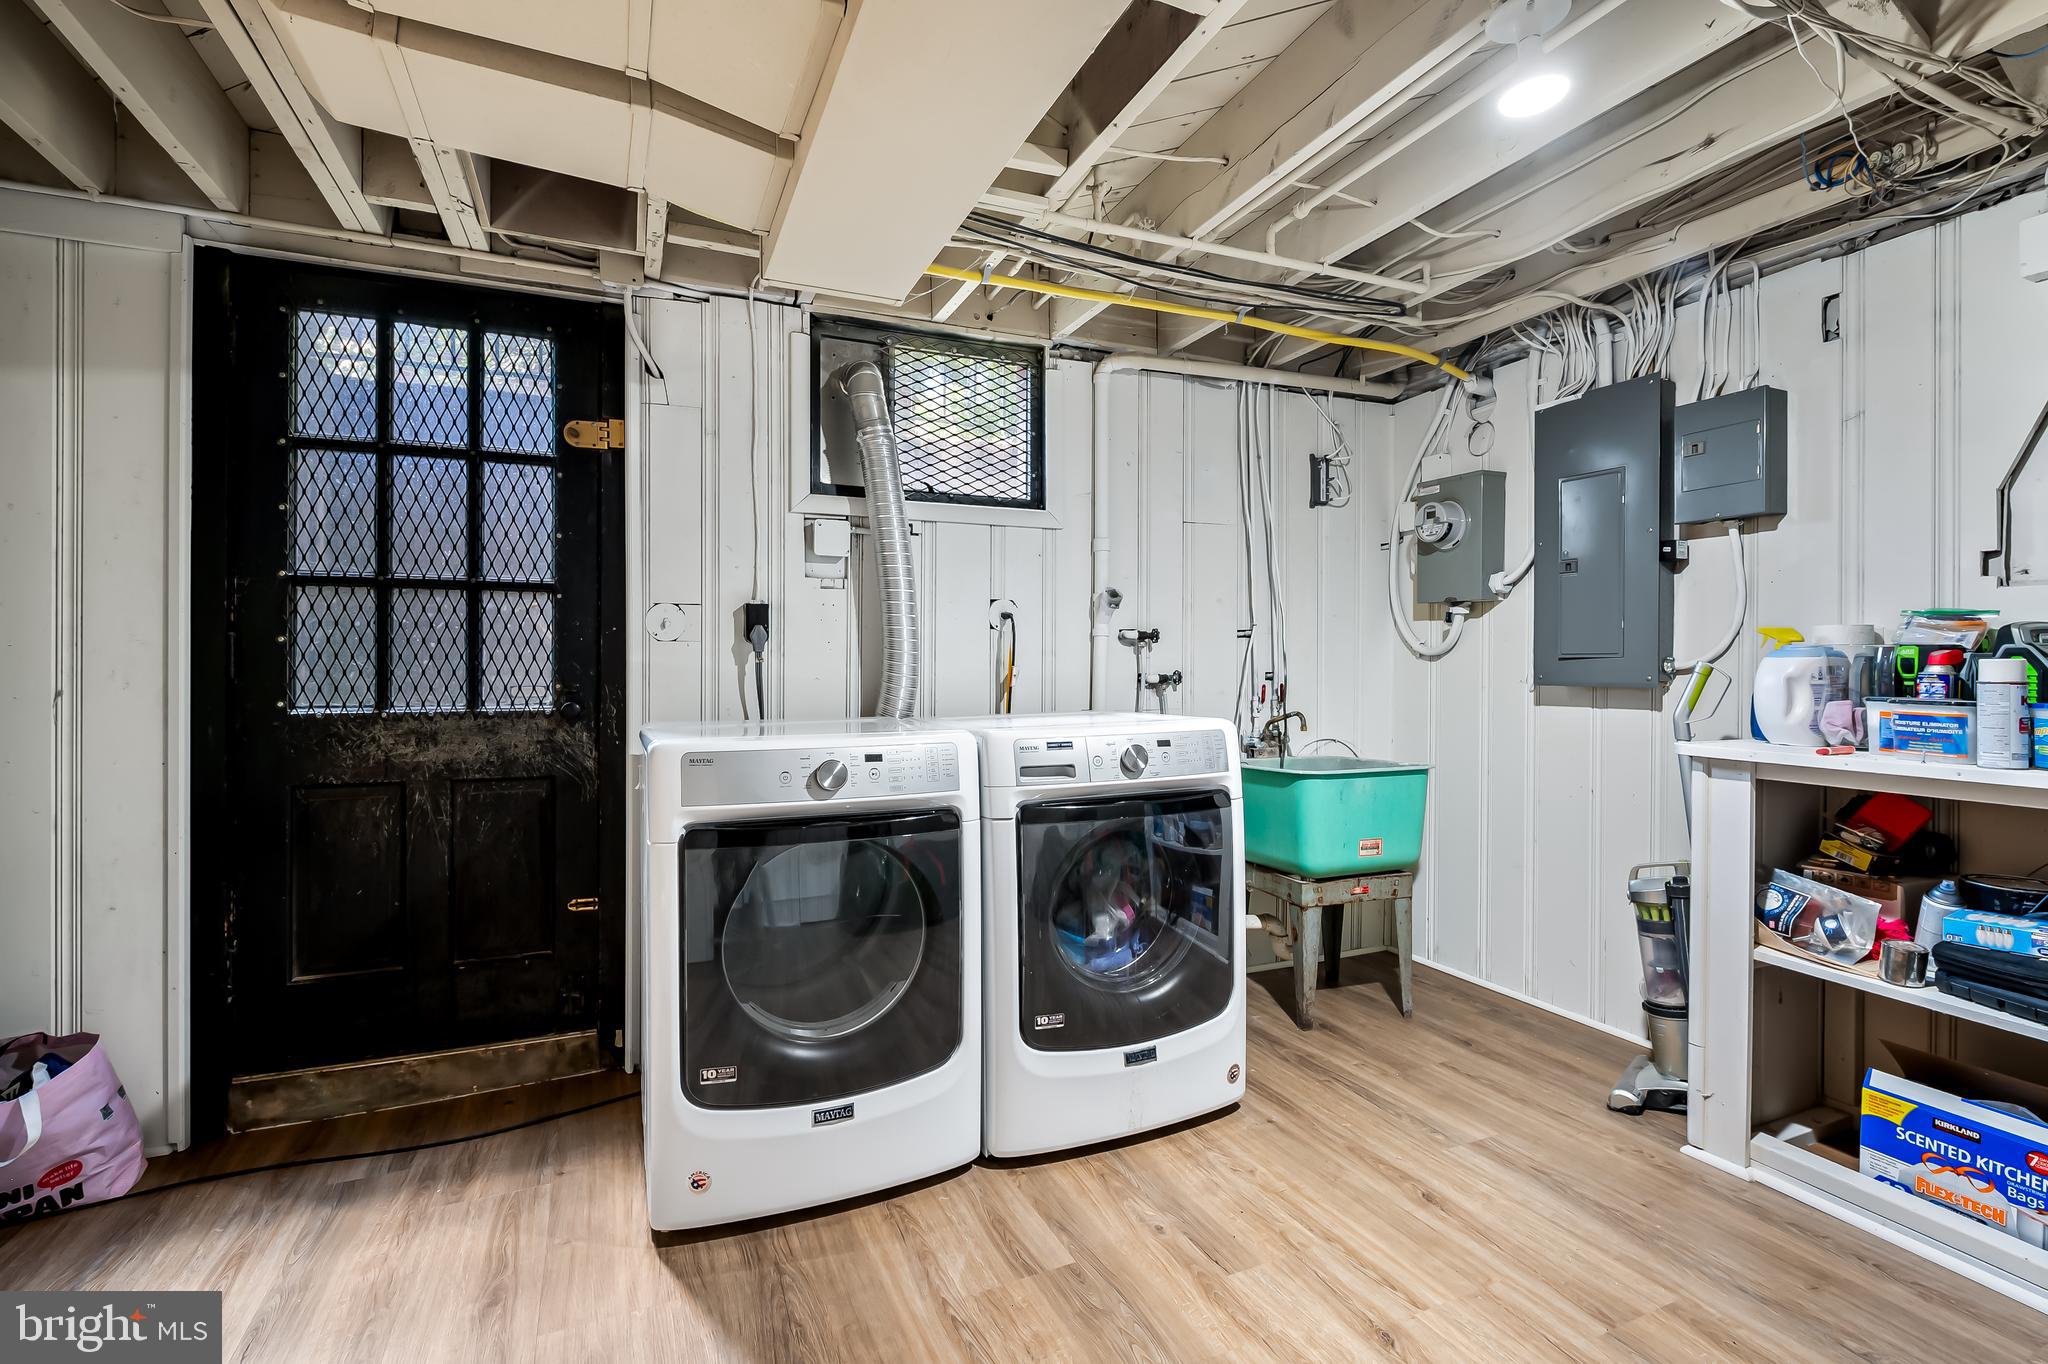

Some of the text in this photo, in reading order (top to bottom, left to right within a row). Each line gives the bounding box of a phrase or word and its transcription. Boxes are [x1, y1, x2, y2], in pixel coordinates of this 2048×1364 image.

[1036, 1016, 1049, 1026] 10
[702, 1069, 717, 1080] 10
[815, 1106, 853, 1122] MAYTAG
[1933, 1118, 1980, 1140] KIRKLAND
[1896, 1126, 1971, 1164] SCENTED
[2027, 1153, 2039, 1167] 7
[2006, 1180, 2047, 1199] DRAWSTRING
[2007, 1185, 2046, 1210] Bags
[1915, 1174, 2008, 1228] FLEX-TECH
